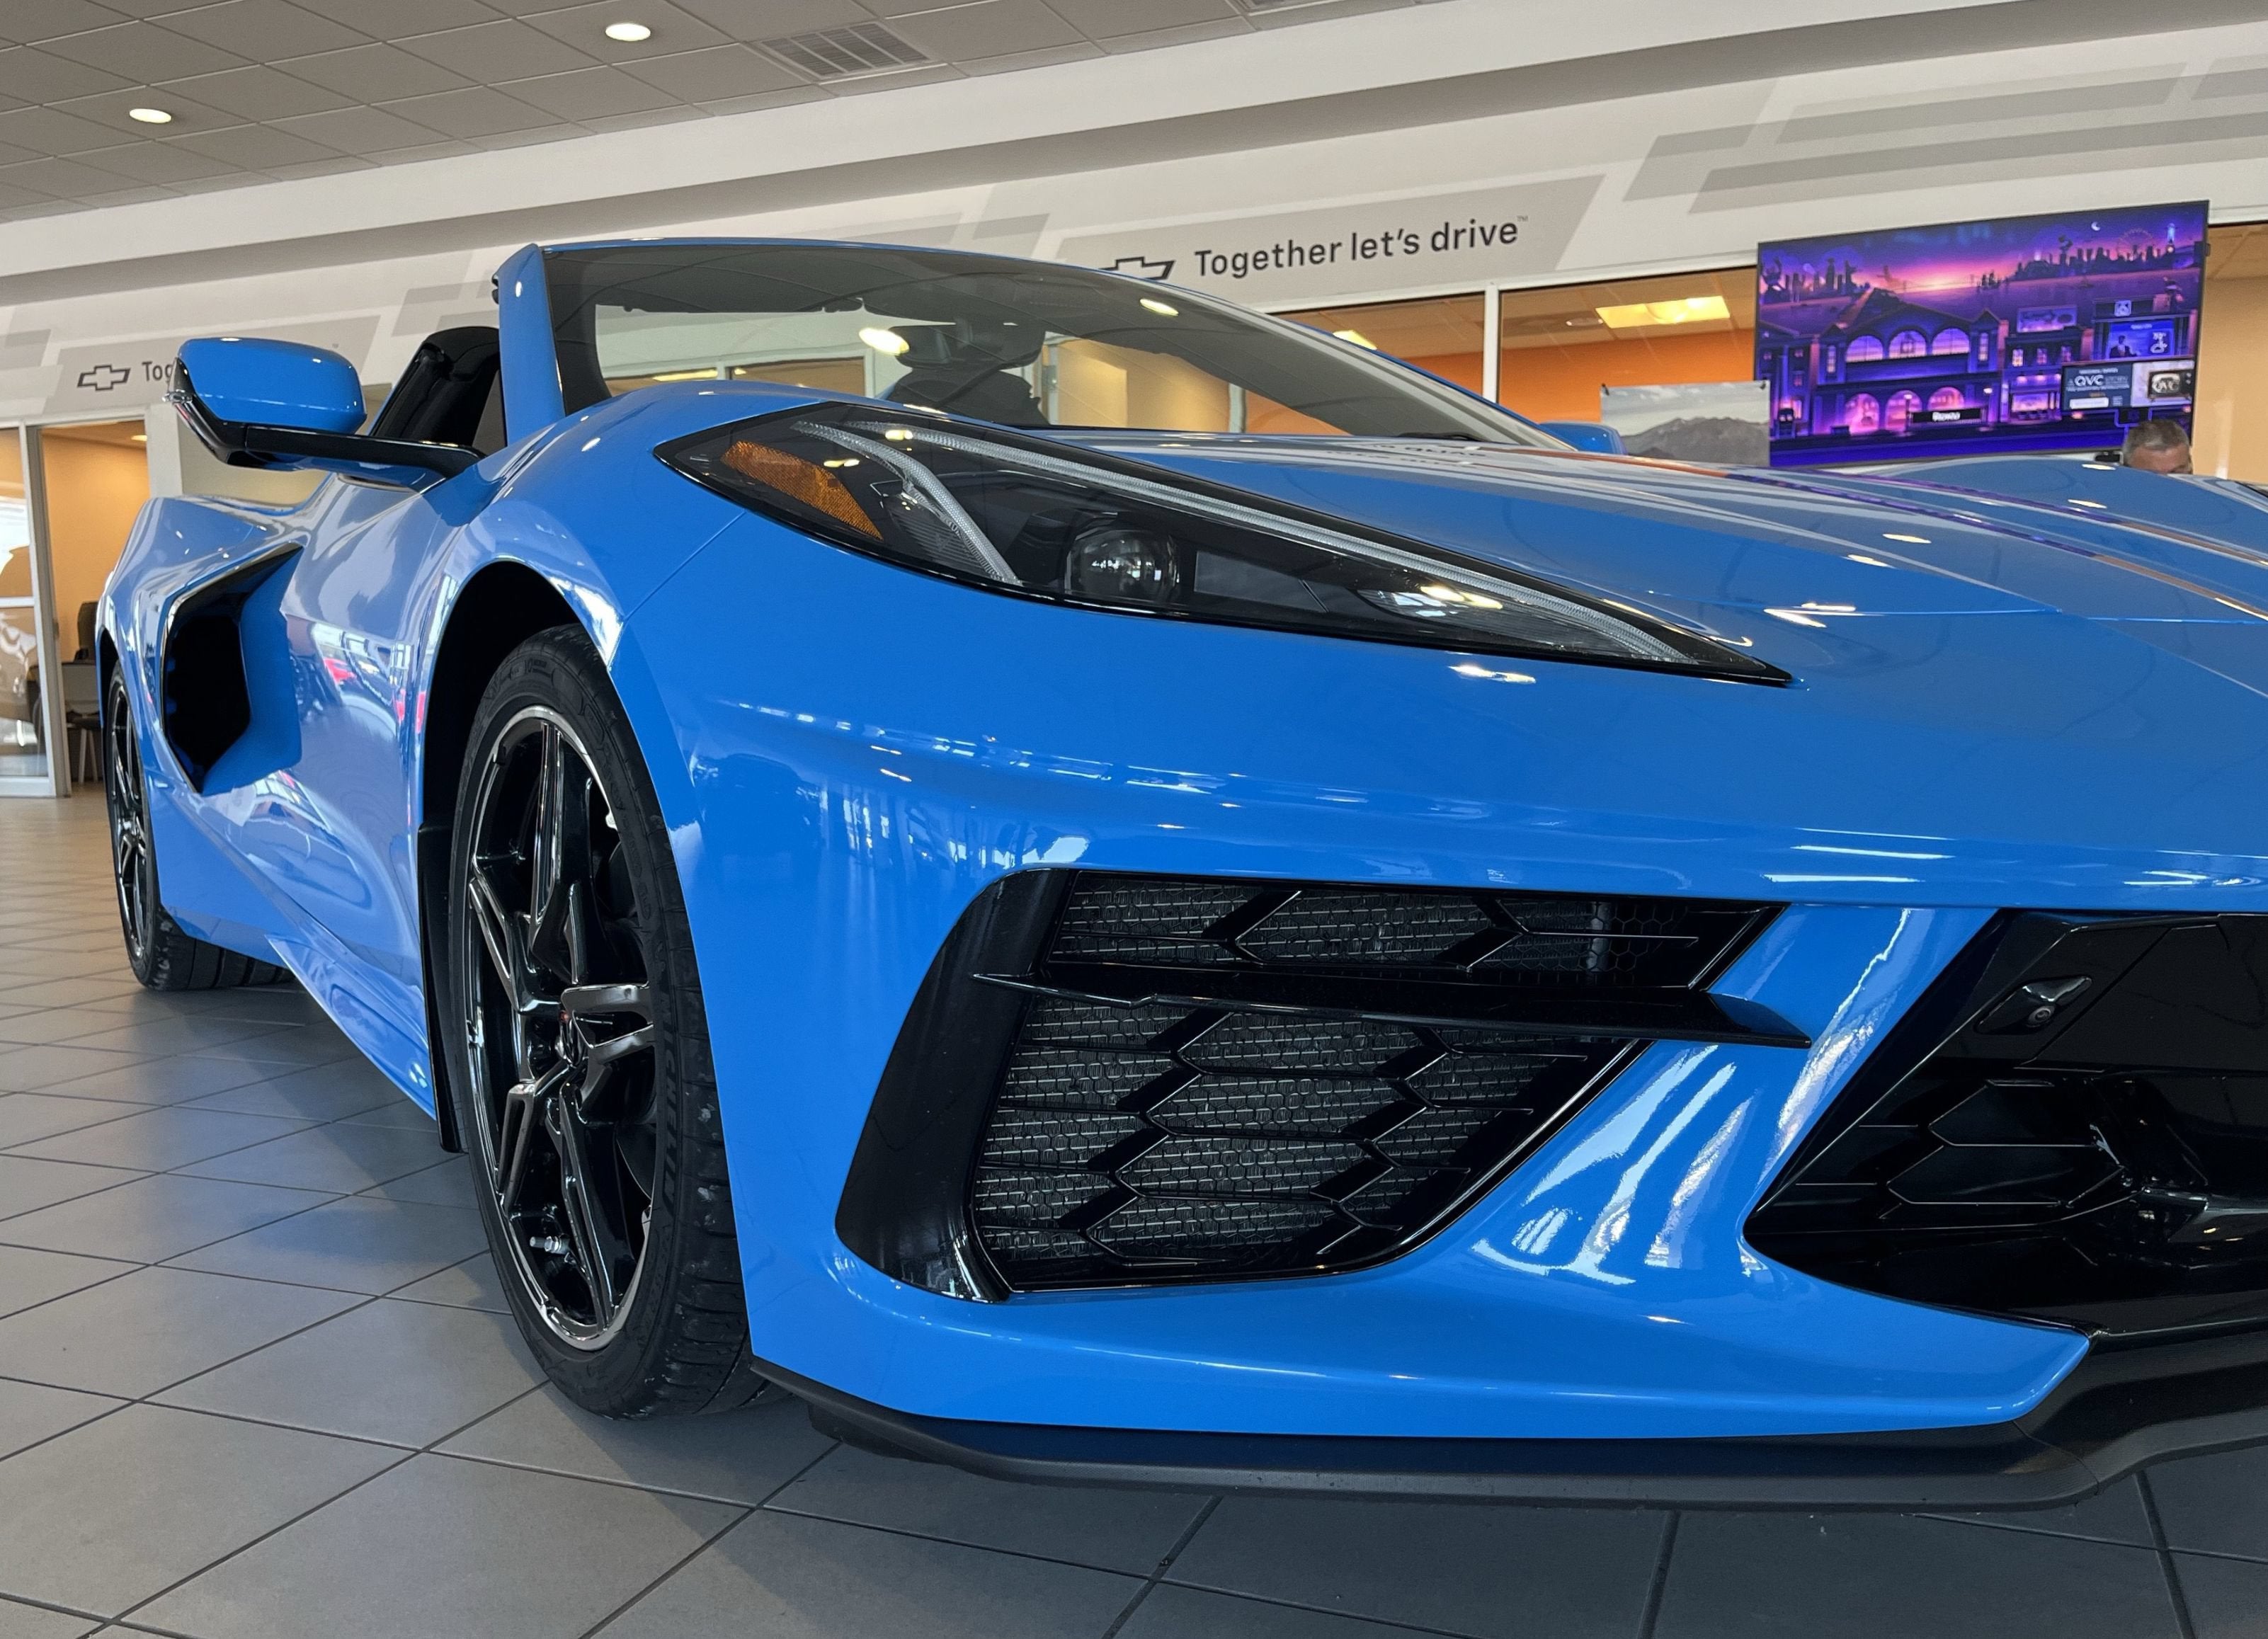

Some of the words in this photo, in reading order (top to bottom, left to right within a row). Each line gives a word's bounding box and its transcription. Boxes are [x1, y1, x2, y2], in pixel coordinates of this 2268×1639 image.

[1195, 239, 1342, 279] Together
[1350, 228, 1420, 260] let's
[2074, 375, 2104, 387] QVC
[660, 991, 677, 1205] MICHELIN
